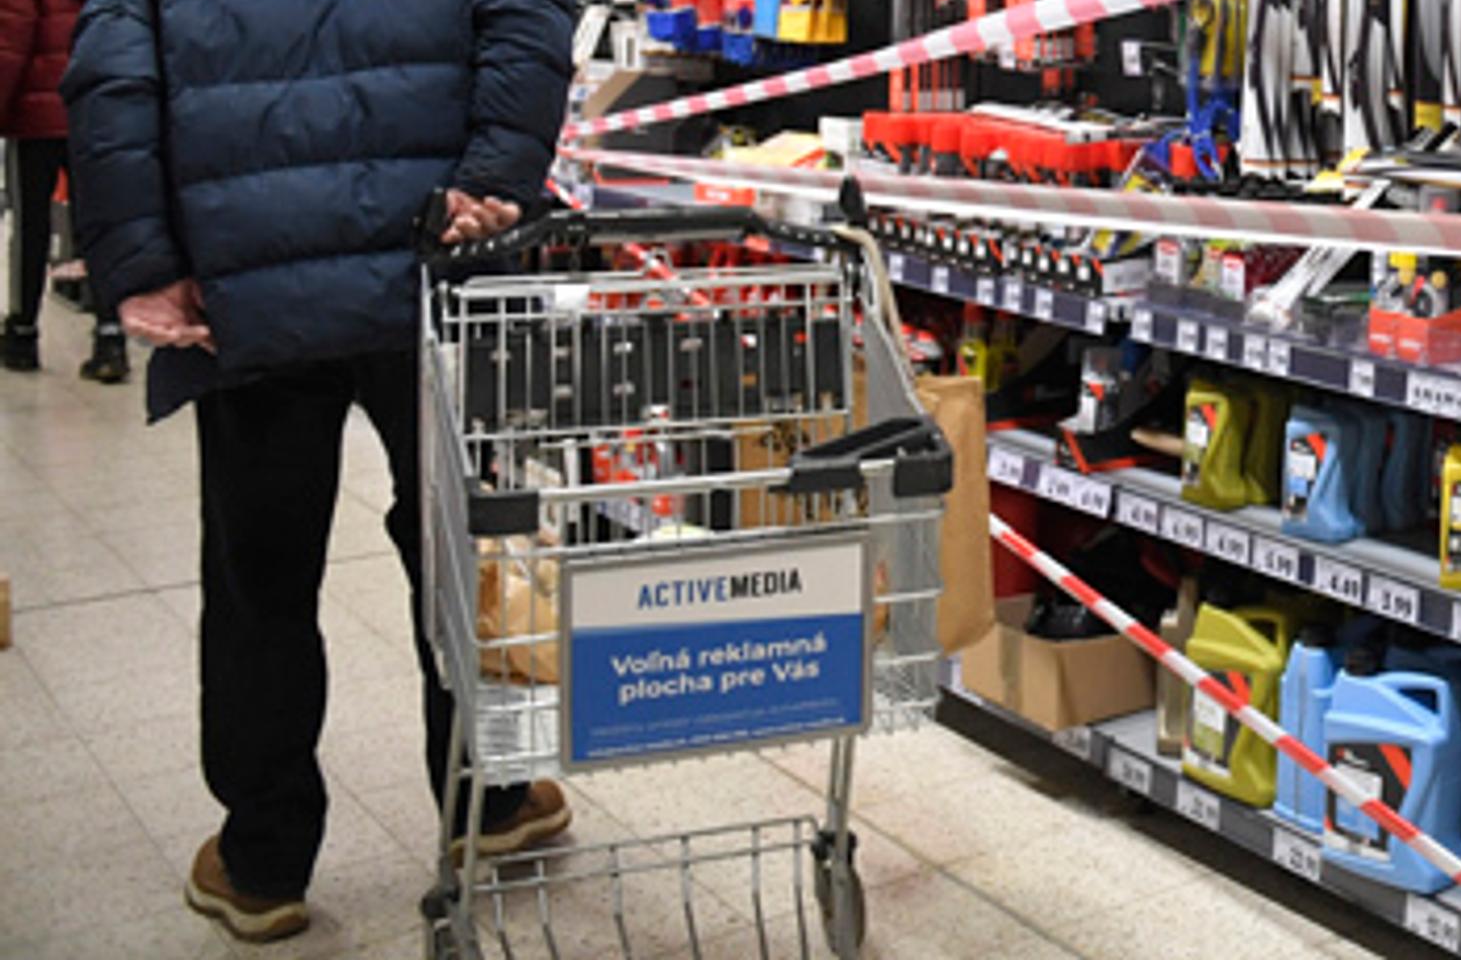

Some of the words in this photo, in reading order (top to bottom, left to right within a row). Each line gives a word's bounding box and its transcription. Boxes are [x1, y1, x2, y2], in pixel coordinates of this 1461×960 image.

[637, 568, 803, 610] ACTIVEMEDIA
[699, 632, 827, 669] reklamná
[619, 672, 712, 706] plocha
[721, 667, 766, 692] pre
[771, 658, 820, 683] Vás
